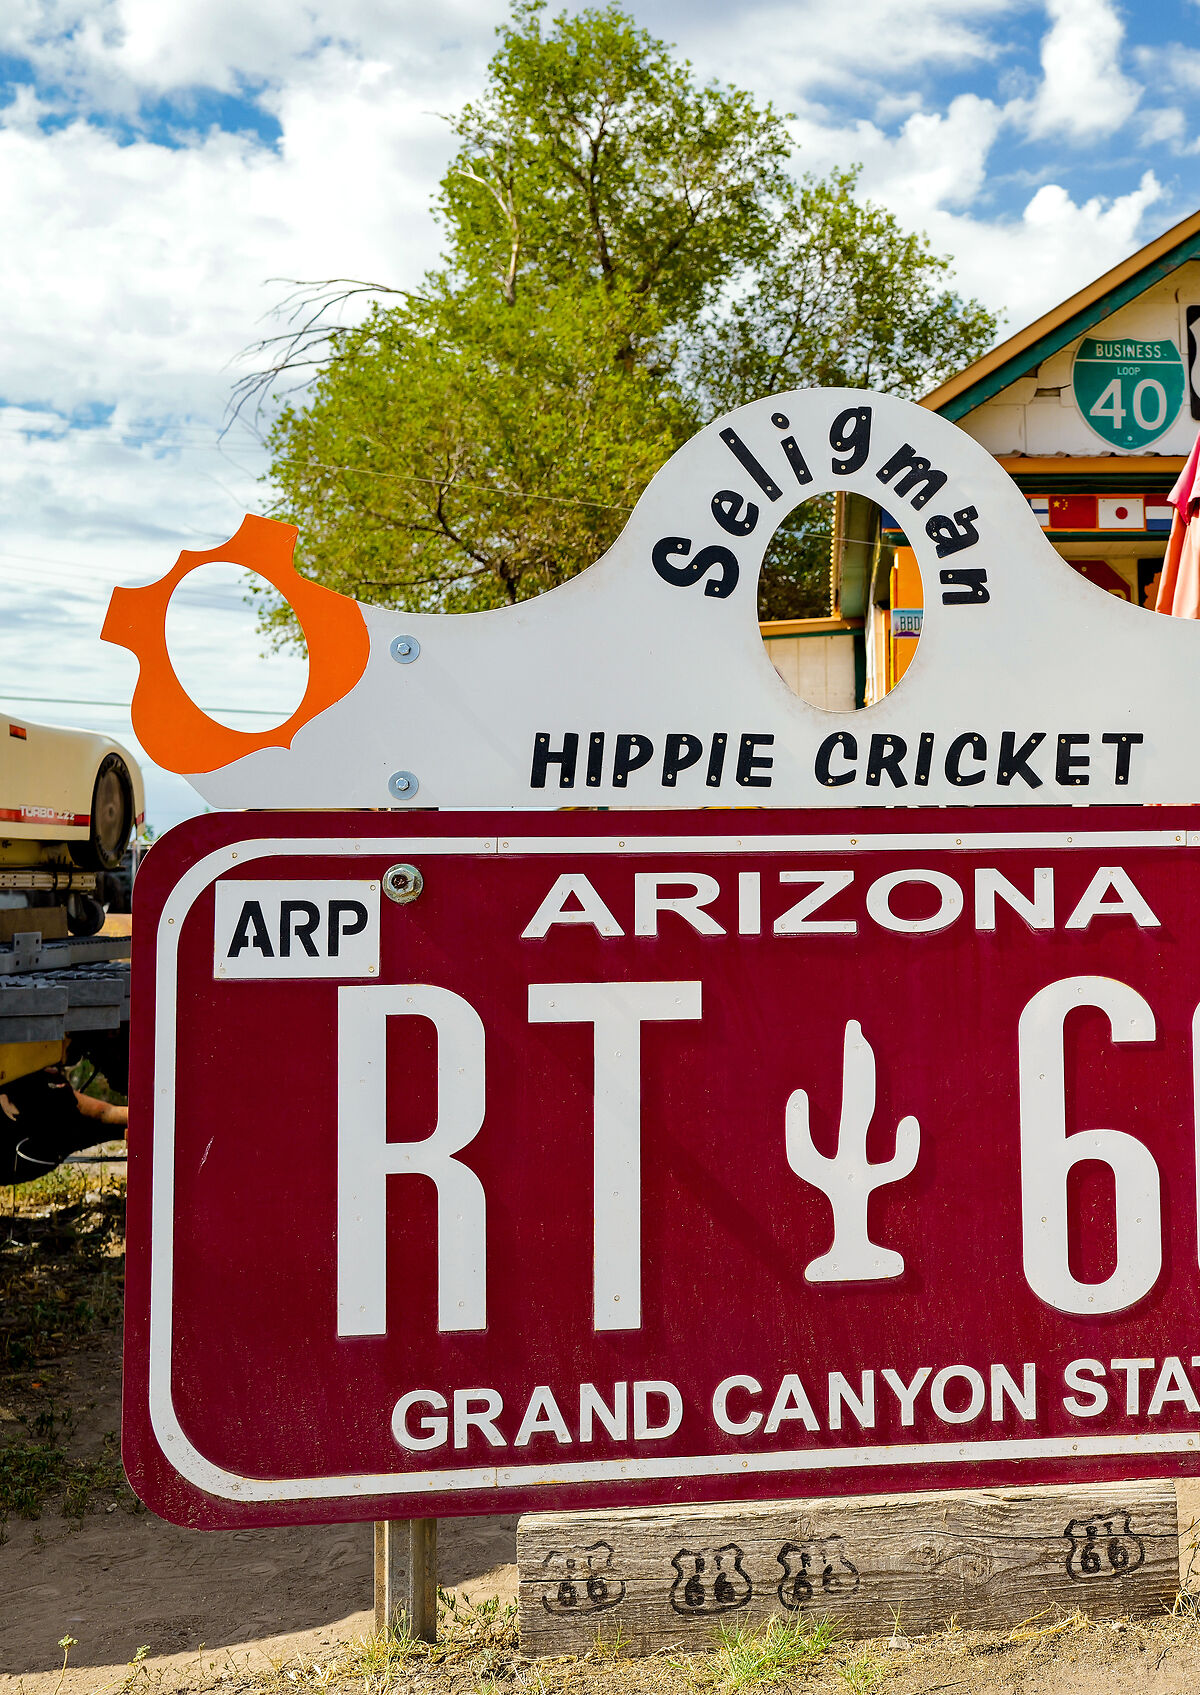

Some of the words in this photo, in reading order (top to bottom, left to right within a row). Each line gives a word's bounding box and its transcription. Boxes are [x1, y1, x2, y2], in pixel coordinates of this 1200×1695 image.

[1096, 344, 1161, 358] BUSINESS
[1117, 367, 1140, 375] LOOP
[1089, 378, 1167, 430] 40
[651, 406, 990, 606] Seligman
[530, 732, 775, 788] HIPPIE
[814, 731, 1144, 789] CRICKET
[20, 805, 55, 819] TURBO
[227, 900, 369, 958] ARP
[520, 866, 1162, 939] ARIZONA
[337, 981, 702, 1336] RT
[391, 1380, 683, 1451] GRAND
[713, 1363, 1037, 1437] CANYON
[1081, 1537, 1129, 1574] 66
